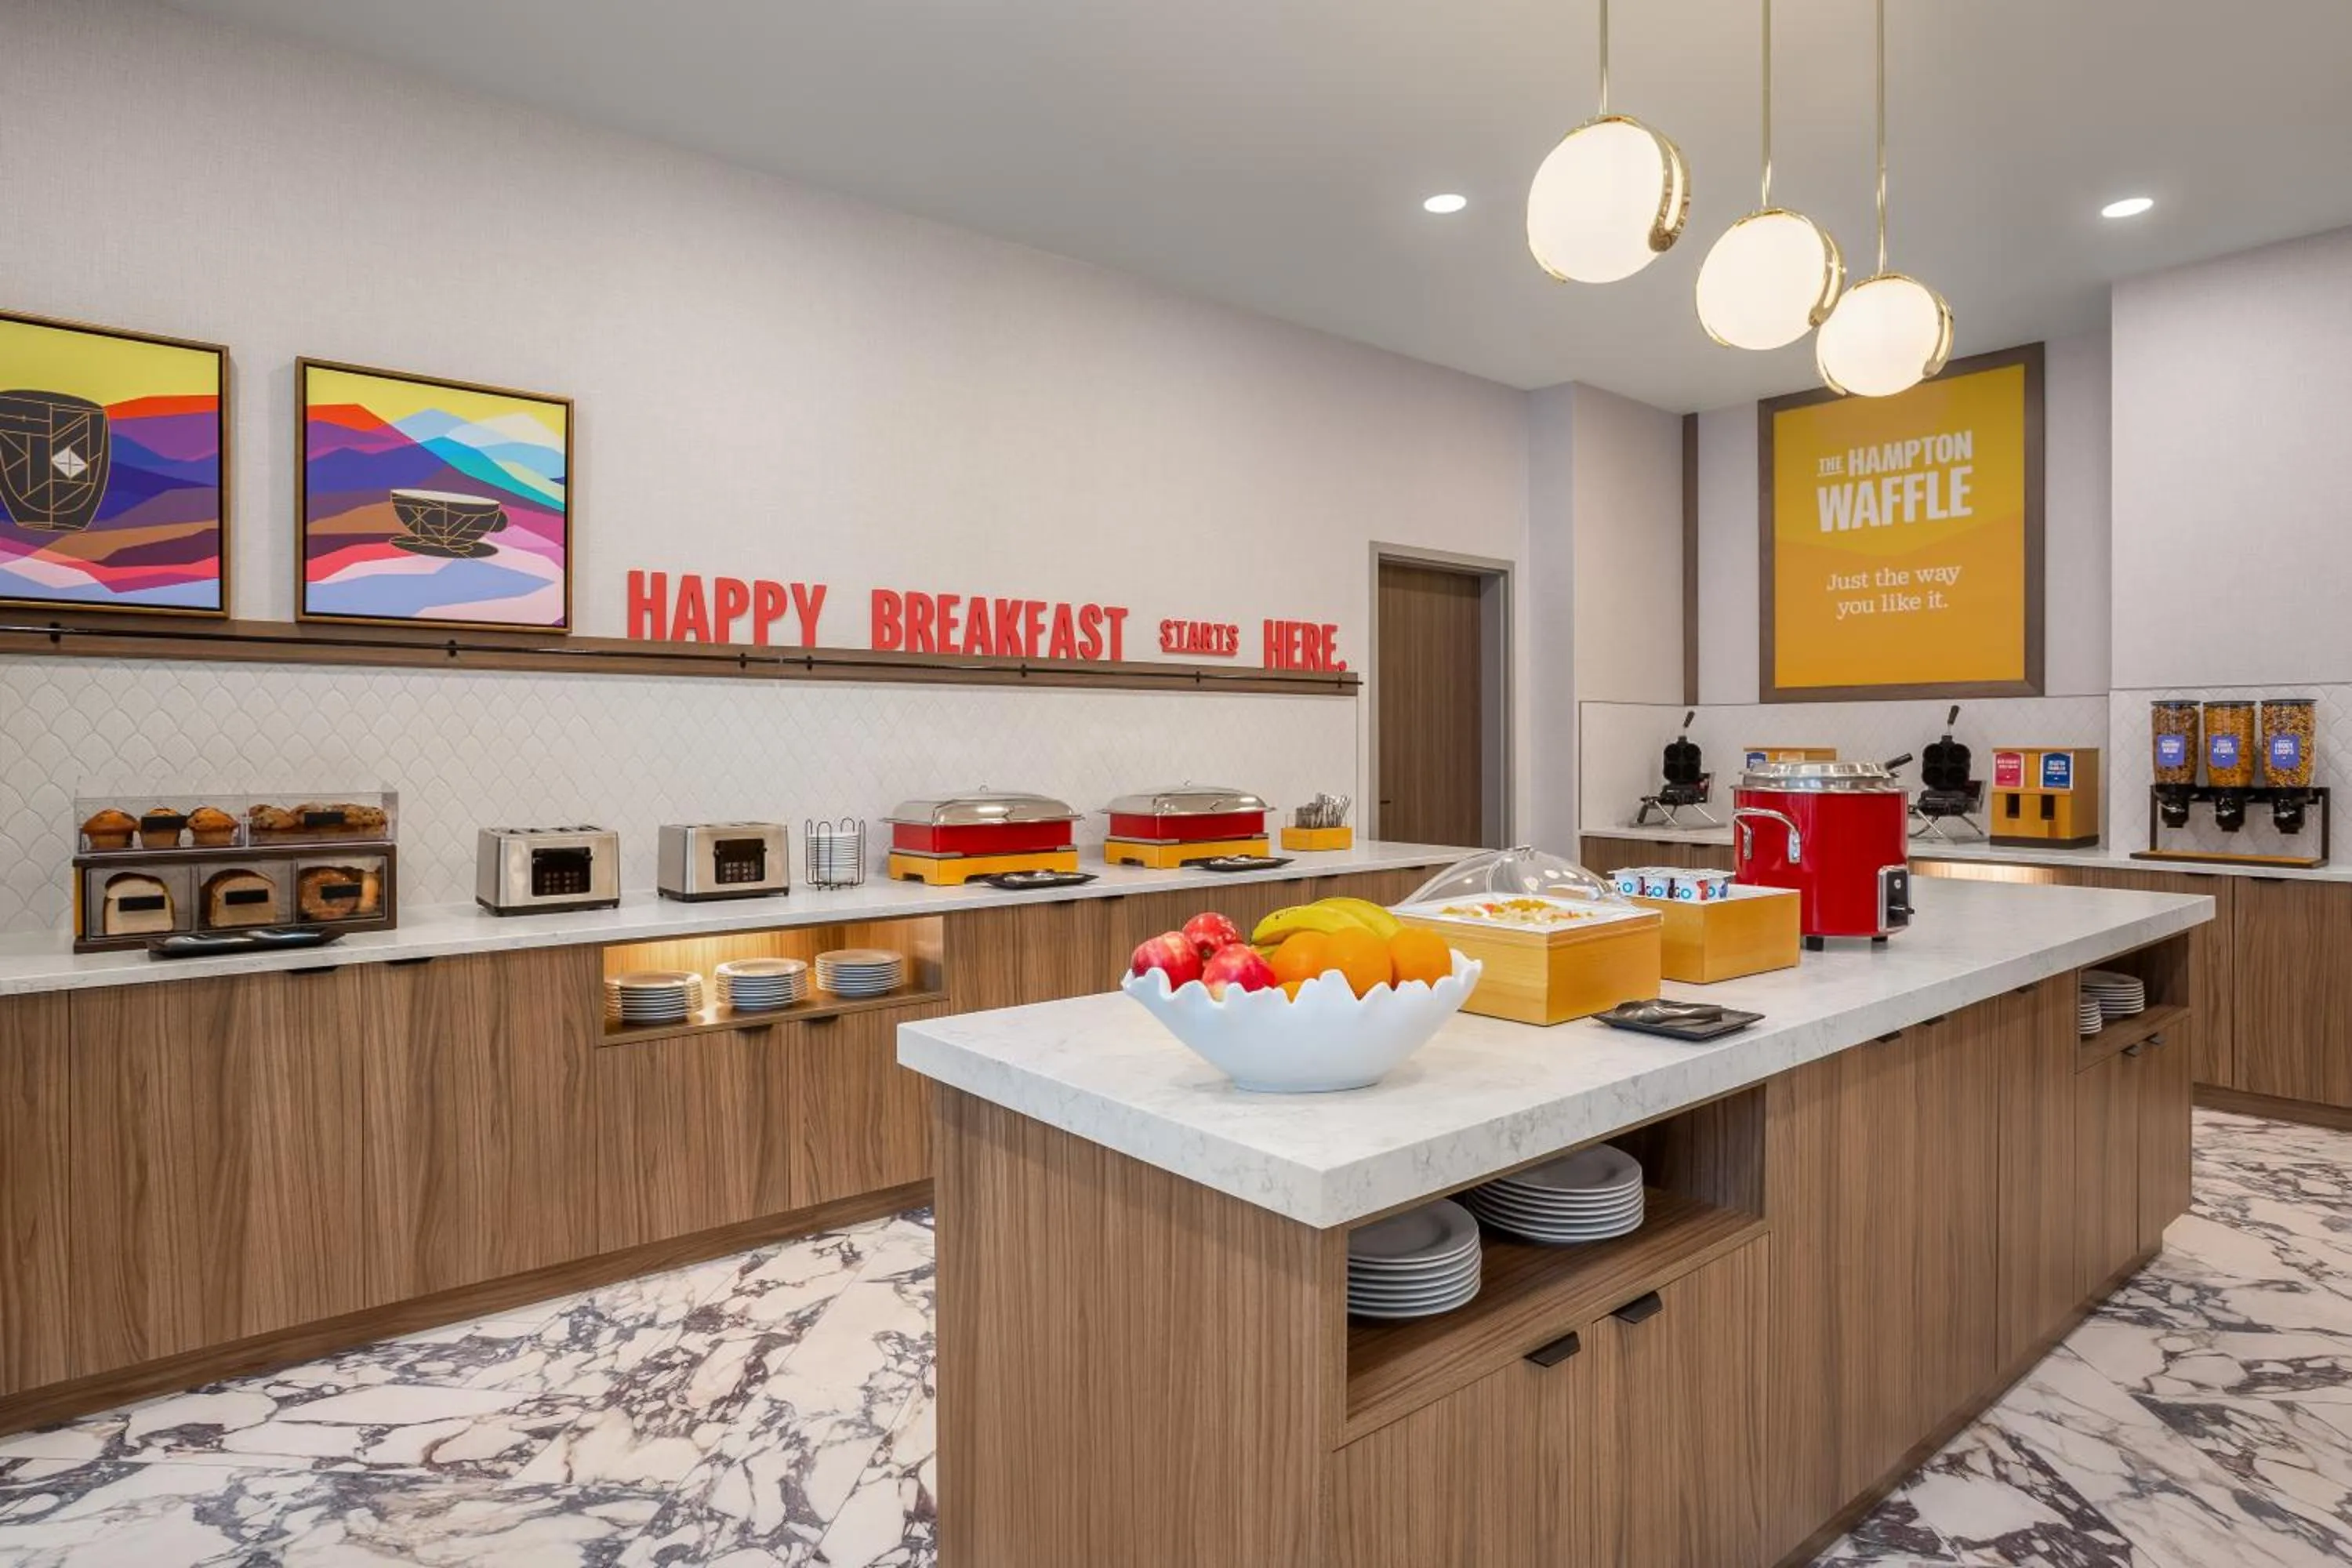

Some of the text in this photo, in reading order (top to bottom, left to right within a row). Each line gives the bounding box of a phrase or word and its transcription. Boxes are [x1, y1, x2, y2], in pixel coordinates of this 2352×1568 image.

[1818, 430, 1973, 477] THE HAMPTON
[1817, 466, 1973, 533] WAFFLE
[1826, 565, 1962, 591] Just the way
[627, 570, 1348, 672] HAPPY BREAKFAST STARTS HERE.
[1836, 590, 1949, 620] you like it.
